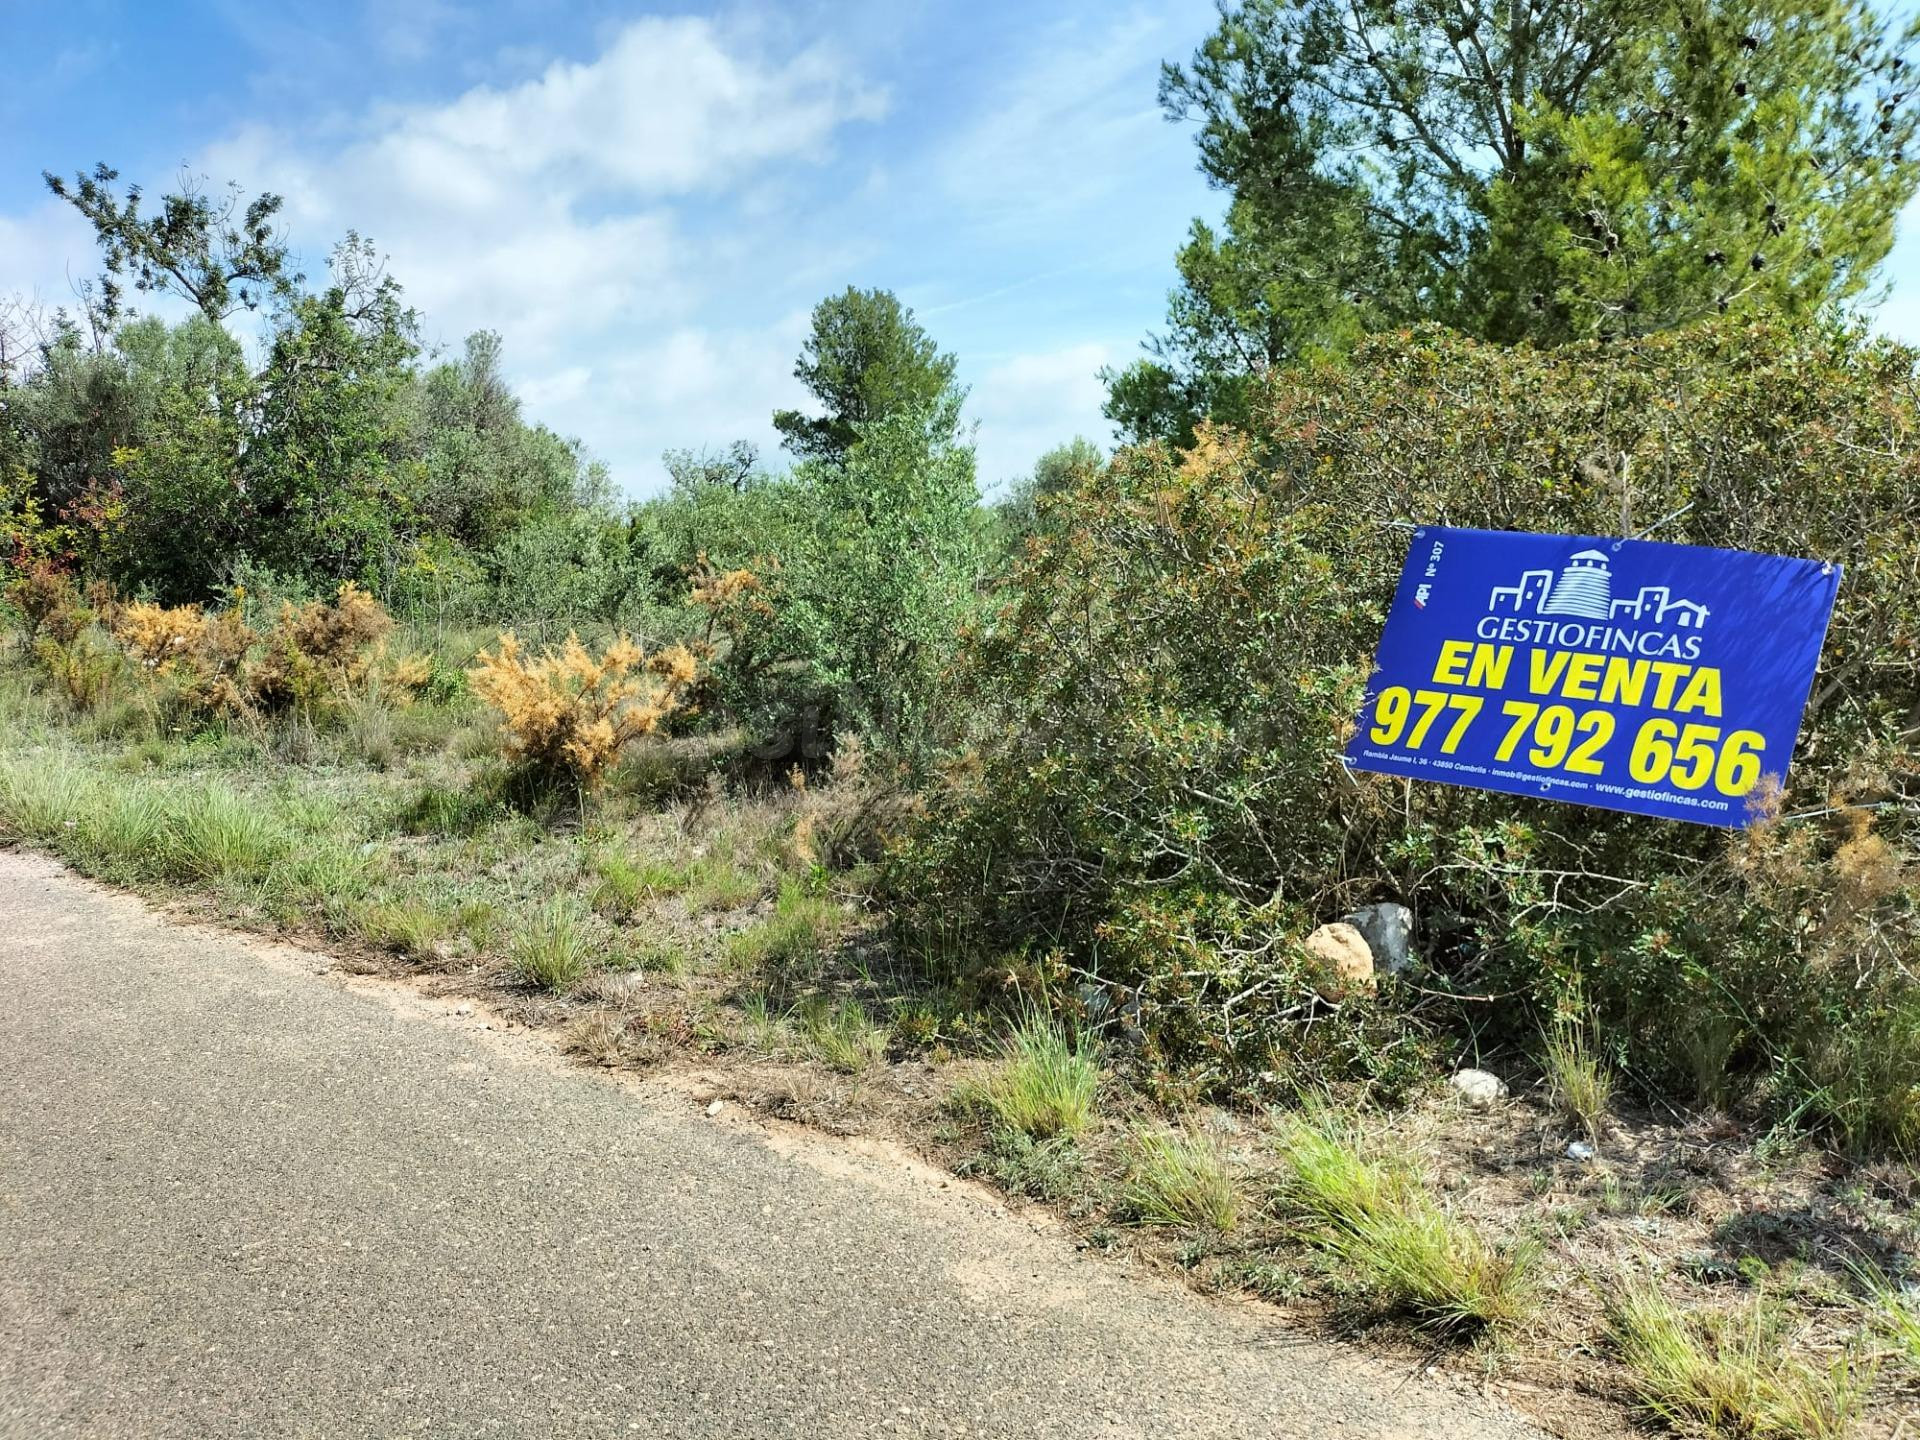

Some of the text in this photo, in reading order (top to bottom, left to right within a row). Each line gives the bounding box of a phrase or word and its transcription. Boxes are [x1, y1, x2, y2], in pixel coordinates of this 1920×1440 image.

[1431, 541, 1444, 562] 307
[1476, 616, 1703, 660] GESTIOFINCAS
[1432, 640, 1724, 718] EN VENTA
[1370, 686, 1485, 755] 977
[1494, 701, 1616, 776] 792
[1629, 718, 1768, 798] 656
[1418, 757, 1428, 765] 36
[1432, 760, 1453, 769] 43850
[1454, 764, 1487, 774] Cambrils
[1595, 784, 1729, 811] www.gestiofincas.com
